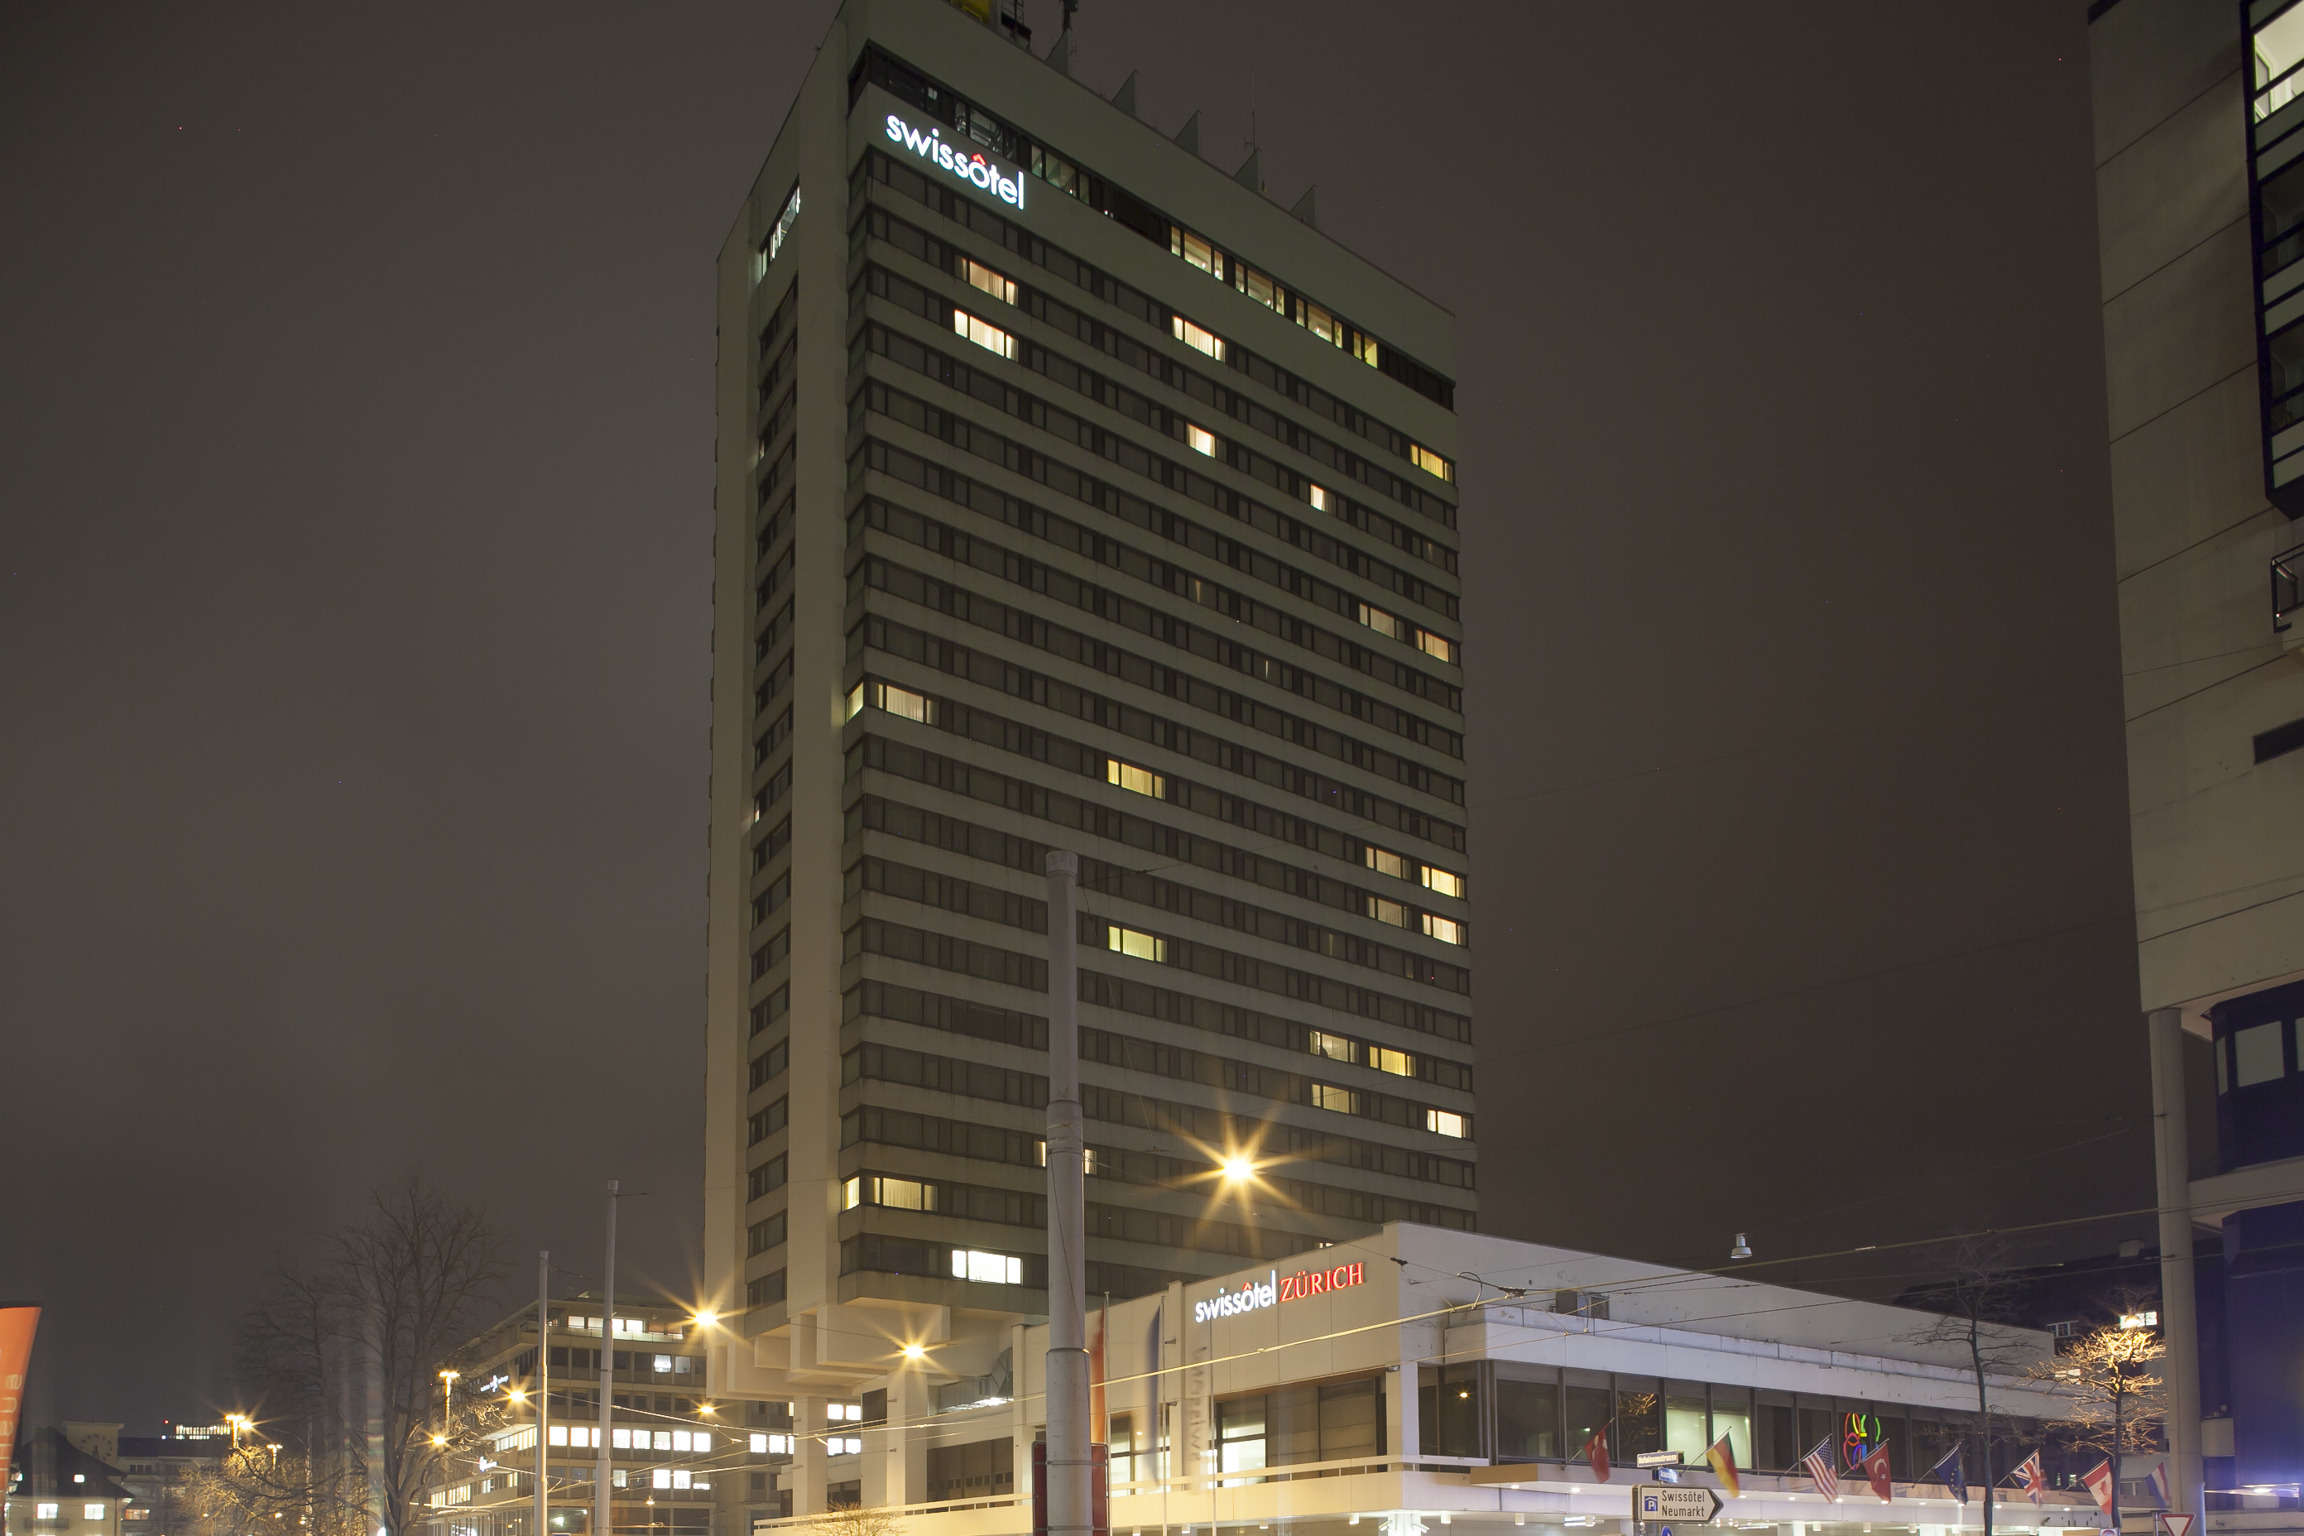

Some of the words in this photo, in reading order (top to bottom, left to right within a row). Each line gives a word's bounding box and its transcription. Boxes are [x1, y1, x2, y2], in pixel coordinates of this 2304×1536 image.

[885, 114, 1025, 211] swissôtel
[1194, 1269, 1276, 1323] swissôtel
[1279, 1262, 1365, 1303] ZÜRICH
[1661, 1489, 1705, 1503] Swissôtel
[1661, 1505, 1705, 1517] Neumarkt
